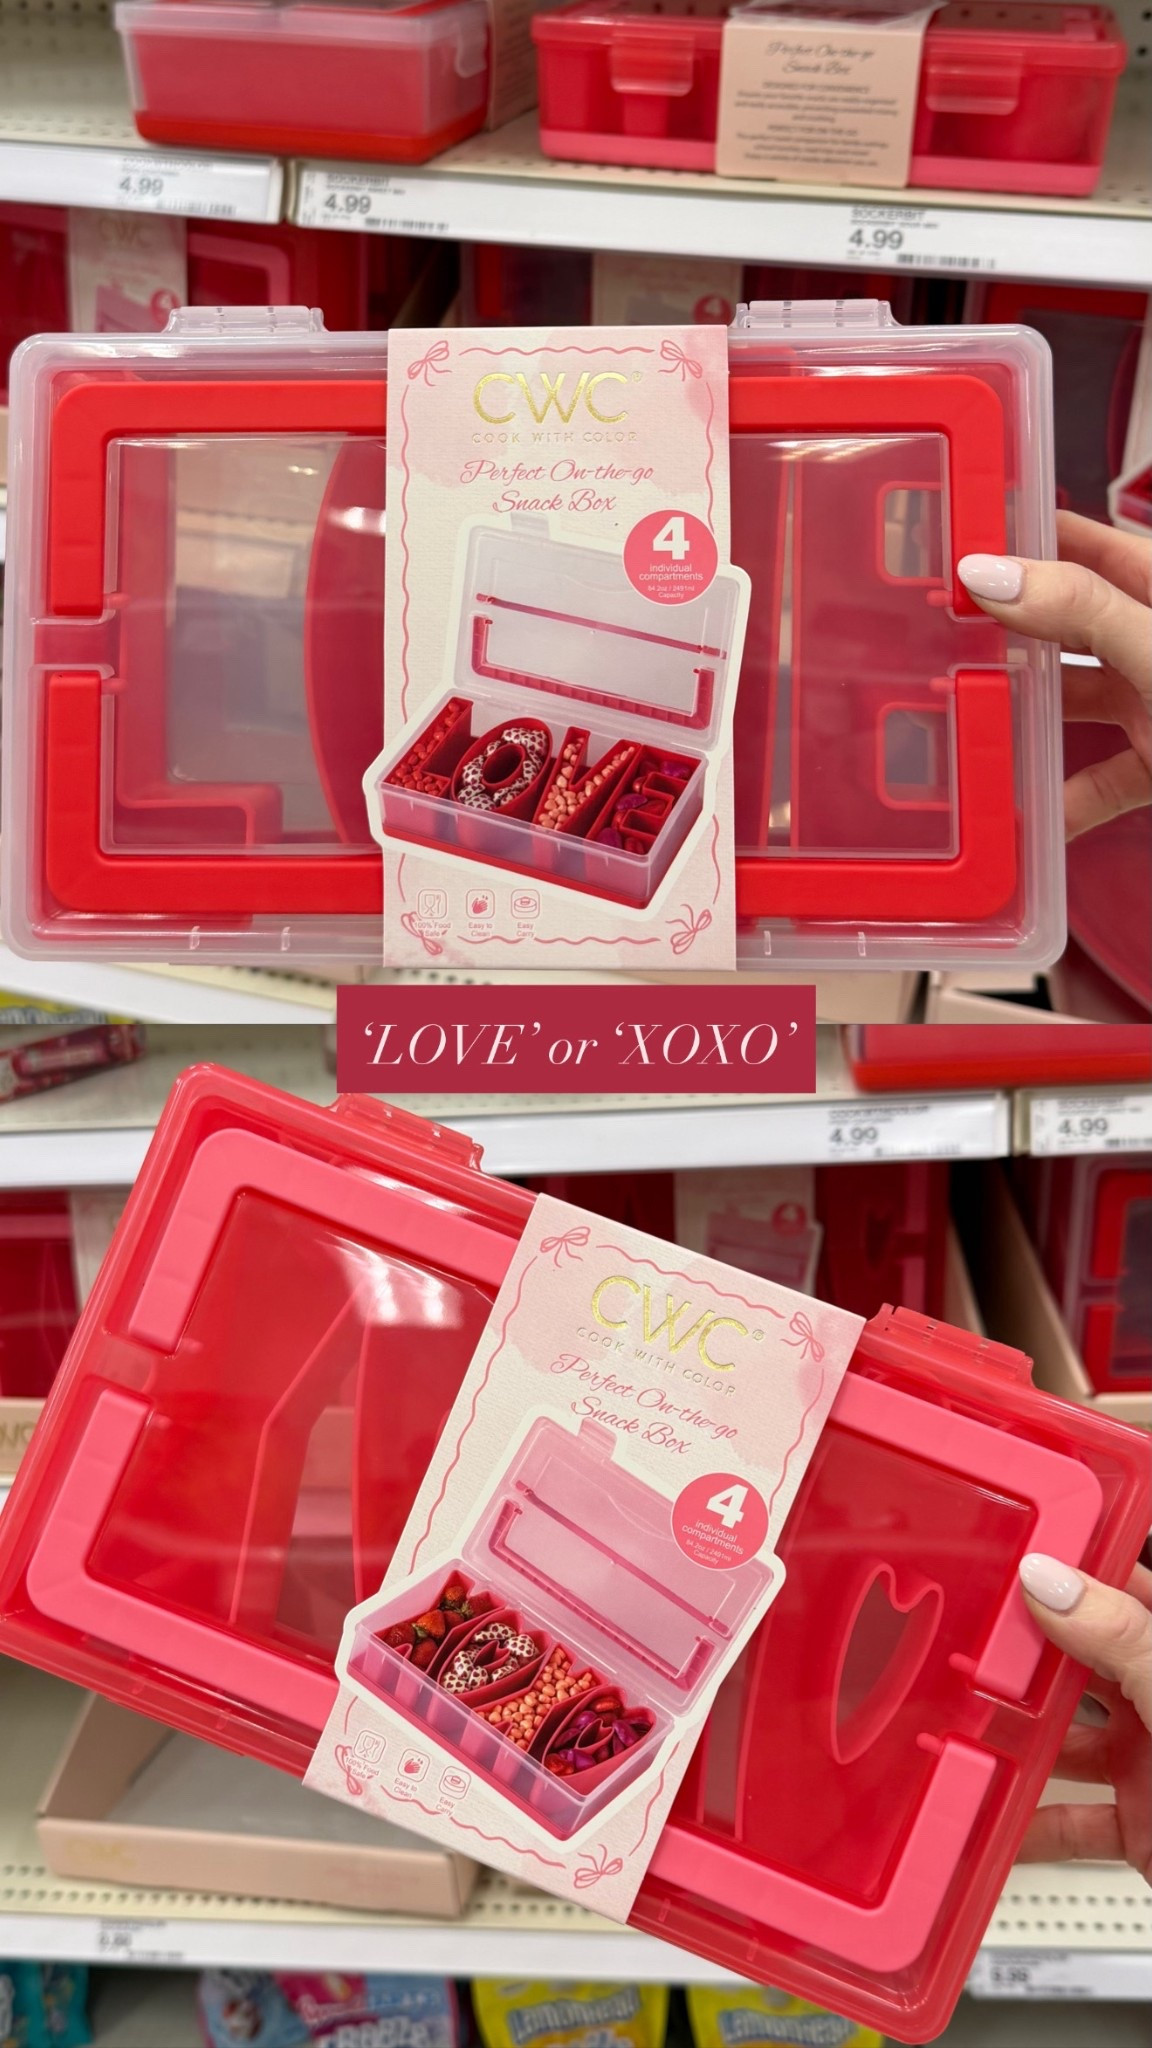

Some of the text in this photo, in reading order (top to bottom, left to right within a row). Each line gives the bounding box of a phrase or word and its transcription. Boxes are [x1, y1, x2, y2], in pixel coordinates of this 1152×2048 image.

[118, 176, 164, 197] 4.99
[324, 193, 372, 215] 4.99
[851, 207, 926, 221] SOCKERBIT
[848, 228, 904, 250] 4.99
[471, 431, 637, 444] COOK WITH COLOR
[460, 458, 654, 486] Perfect On-the-go
[492, 488, 617, 513] Snack Box
[652, 516, 690, 560] 4
[639, 572, 704, 582] compartments
[649, 563, 692, 572] individual
[657, 591, 685, 600] Capacity
[468, 922, 485, 930] Easy
[516, 930, 535, 939] Carry
[517, 922, 534, 930] Easy
[829, 1126, 878, 1145] 4.99
[1057, 1118, 1108, 1137] 4.99
[576, 1326, 737, 1397] COOK WITH COLOR
[550, 1353, 738, 1440] Perfect On-the-go
[570, 1396, 692, 1454] Snack Box
[706, 1483, 749, 1529] 4
[681, 1524, 744, 1556] compartments
[695, 1519, 738, 1543] individual
[693, 1548, 719, 1566] Capacity
[345, 1756, 380, 1776] 100% Food
[352, 1768, 366, 1779] Safe
[393, 1786, 412, 1798] Clean
[394, 1777, 418, 1792] Easy to
[435, 1804, 454, 1817] Carry
[439, 1796, 456, 1809] Easy
